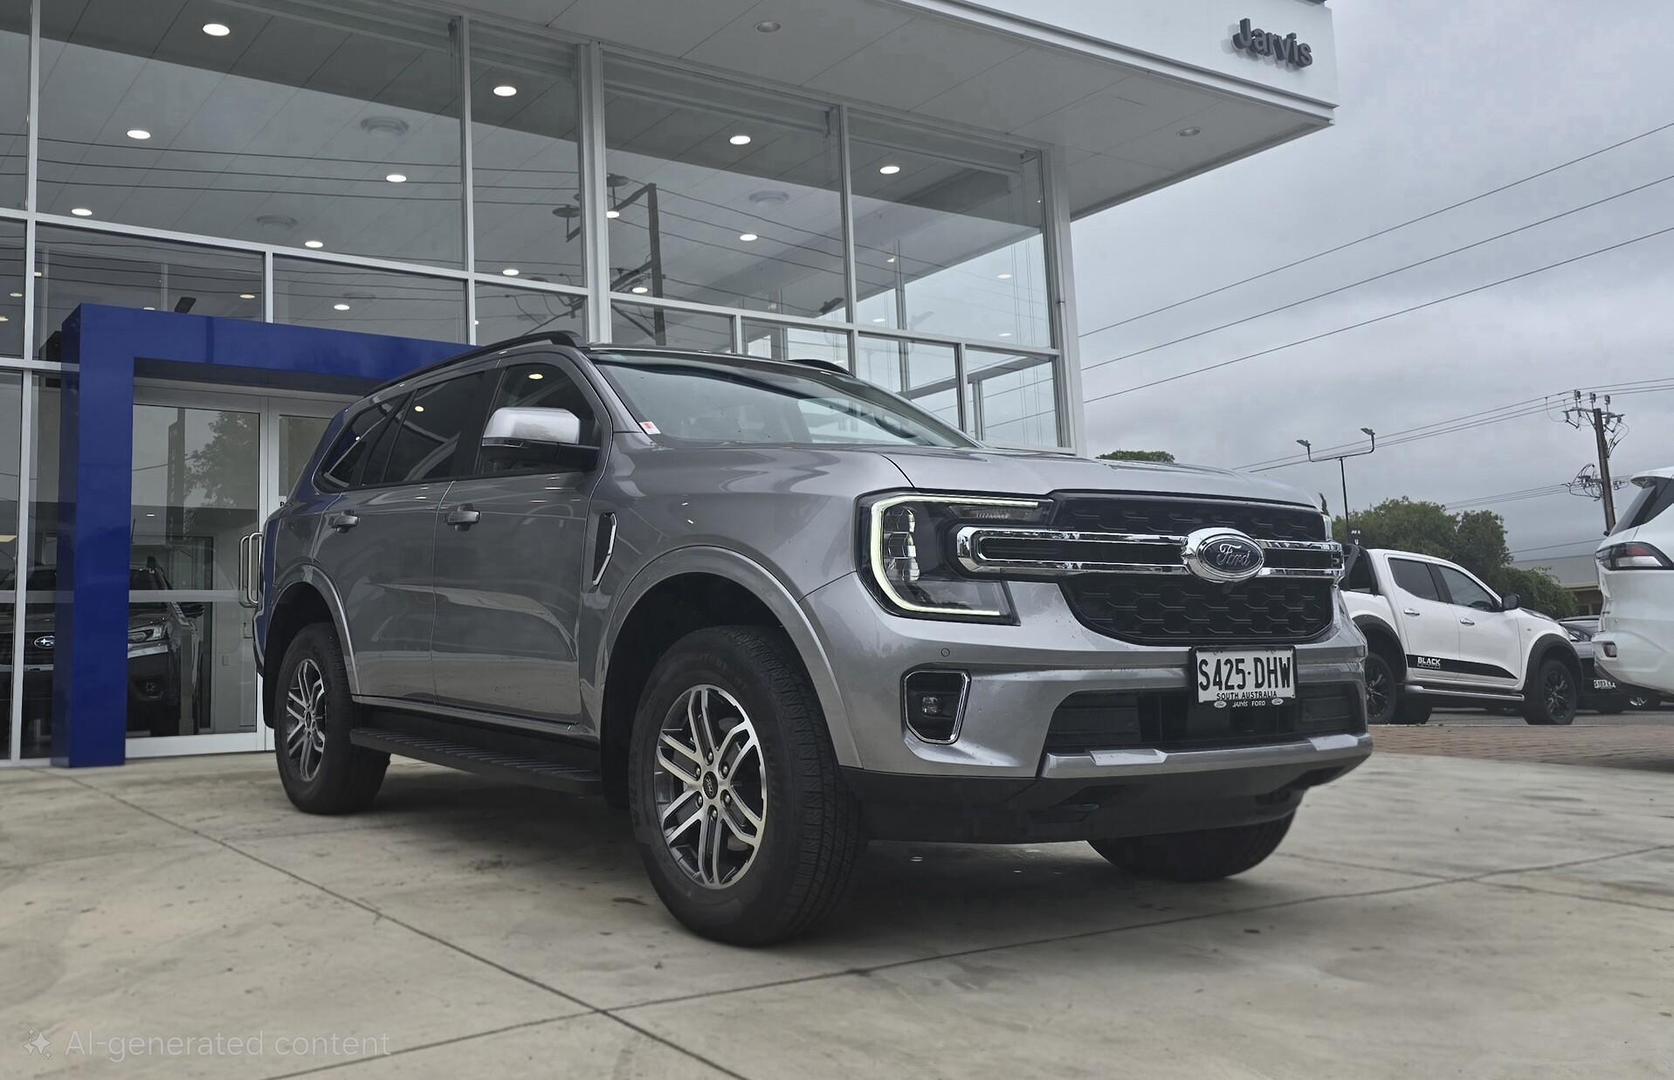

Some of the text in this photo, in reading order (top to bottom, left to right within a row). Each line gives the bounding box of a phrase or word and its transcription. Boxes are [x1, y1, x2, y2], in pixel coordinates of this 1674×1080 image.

[1231, 17, 1313, 68] Jarvis
[1216, 543, 1251, 566] Ford
[1417, 656, 1440, 666] BLACK
[1216, 690, 1277, 700] SOUTH AUSTRALIA
